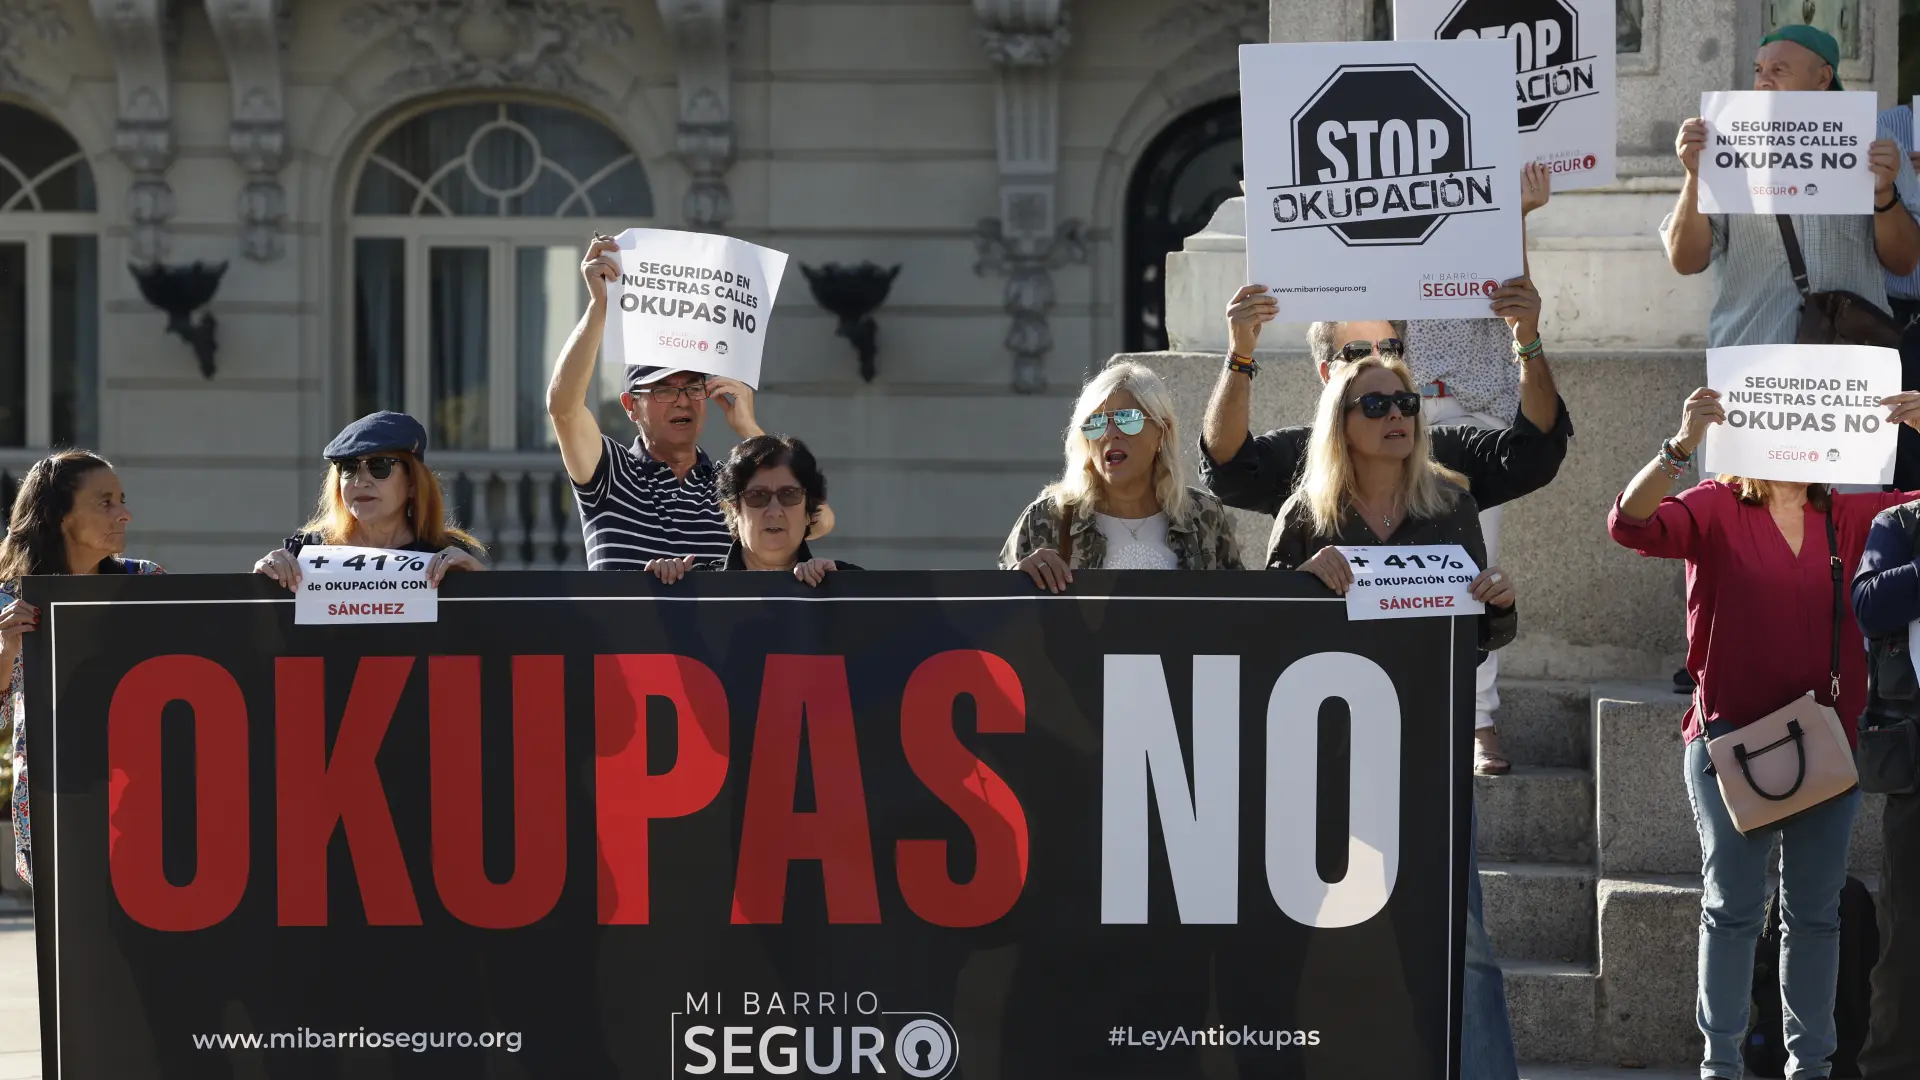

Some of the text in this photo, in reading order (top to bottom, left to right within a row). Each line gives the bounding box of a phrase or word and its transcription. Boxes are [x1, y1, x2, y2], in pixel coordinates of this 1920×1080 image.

[1456, 18, 1562, 73] OP
[1731, 121, 1843, 132] SEGURIDAD EN
[1716, 135, 1858, 146] NUESTRAS CALLES
[1316, 118, 1450, 184] STOP
[1715, 152, 1857, 169] OKUPAS NO
[1272, 172, 1493, 224] OKUPACIÓN
[639, 262, 750, 290] SEGURIDAD EN
[1439, 272, 1478, 280] BARRIO
[621, 273, 758, 309] NUESTRAS CALLES
[1272, 285, 1367, 294] www.mibarrioseguro.org
[620, 293, 756, 334] OKUPAS NO
[1744, 376, 1868, 392] SEGURIDAD EN
[1728, 391, 1882, 408] NUESTRAS CALLES
[1727, 409, 1880, 433] OKUPAS NO
[342, 554, 425, 572] 41%
[1383, 554, 1464, 570] 41%
[307, 579, 428, 591] de OKUPACIÓN CON
[1357, 574, 1473, 587] de OKUPACIÓN CON
[328, 601, 405, 616] SÁNCHEZ
[1379, 596, 1455, 610] SÁNCHEZ
[107, 649, 1402, 932] OKUPAS NO
[686, 991, 878, 1015] MI BARRIO
[192, 1027, 522, 1053] www.mibarrioseguro.org
[1108, 1024, 1321, 1050] #LeyAntiokupas
